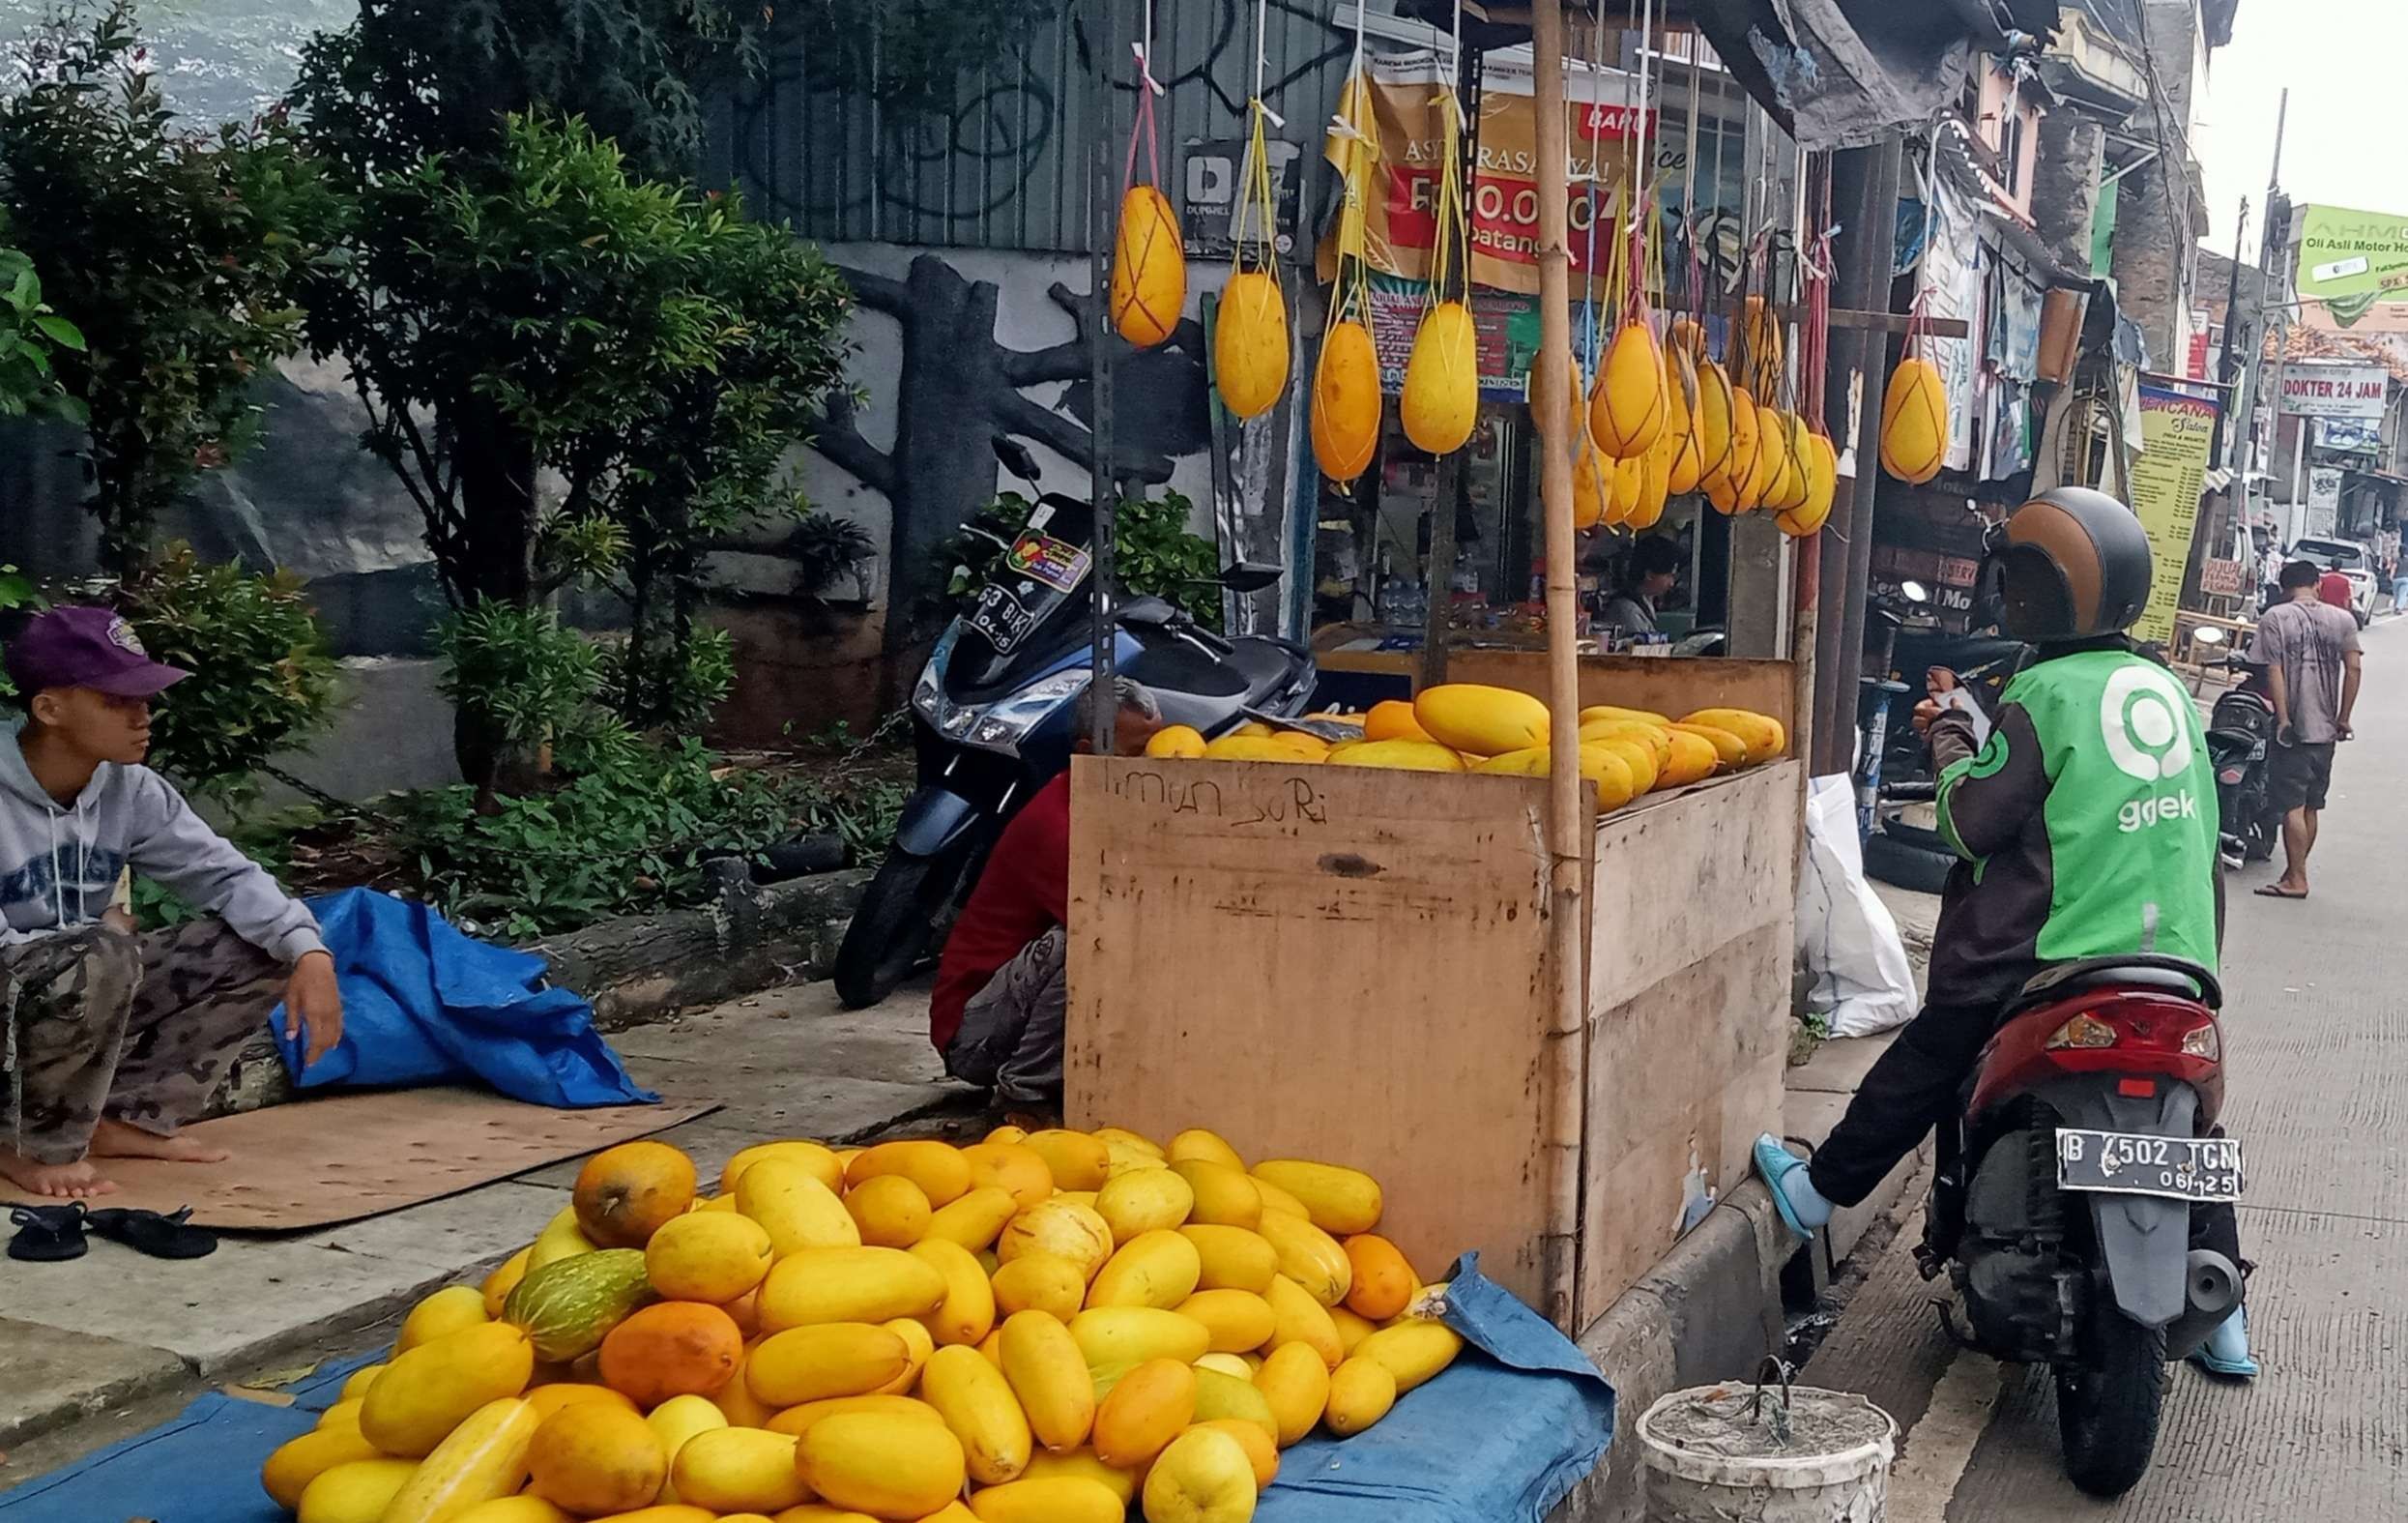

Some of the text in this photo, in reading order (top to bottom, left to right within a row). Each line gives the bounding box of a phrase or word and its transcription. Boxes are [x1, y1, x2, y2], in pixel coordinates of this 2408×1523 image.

[1587, 109, 1649, 133] BARU
[2327, 239, 2351, 250] Asli
[2354, 241, 2391, 252] Motor
[2283, 379, 2382, 398] DOKTER 24 JAM
[2068, 1135, 2083, 1161] B
